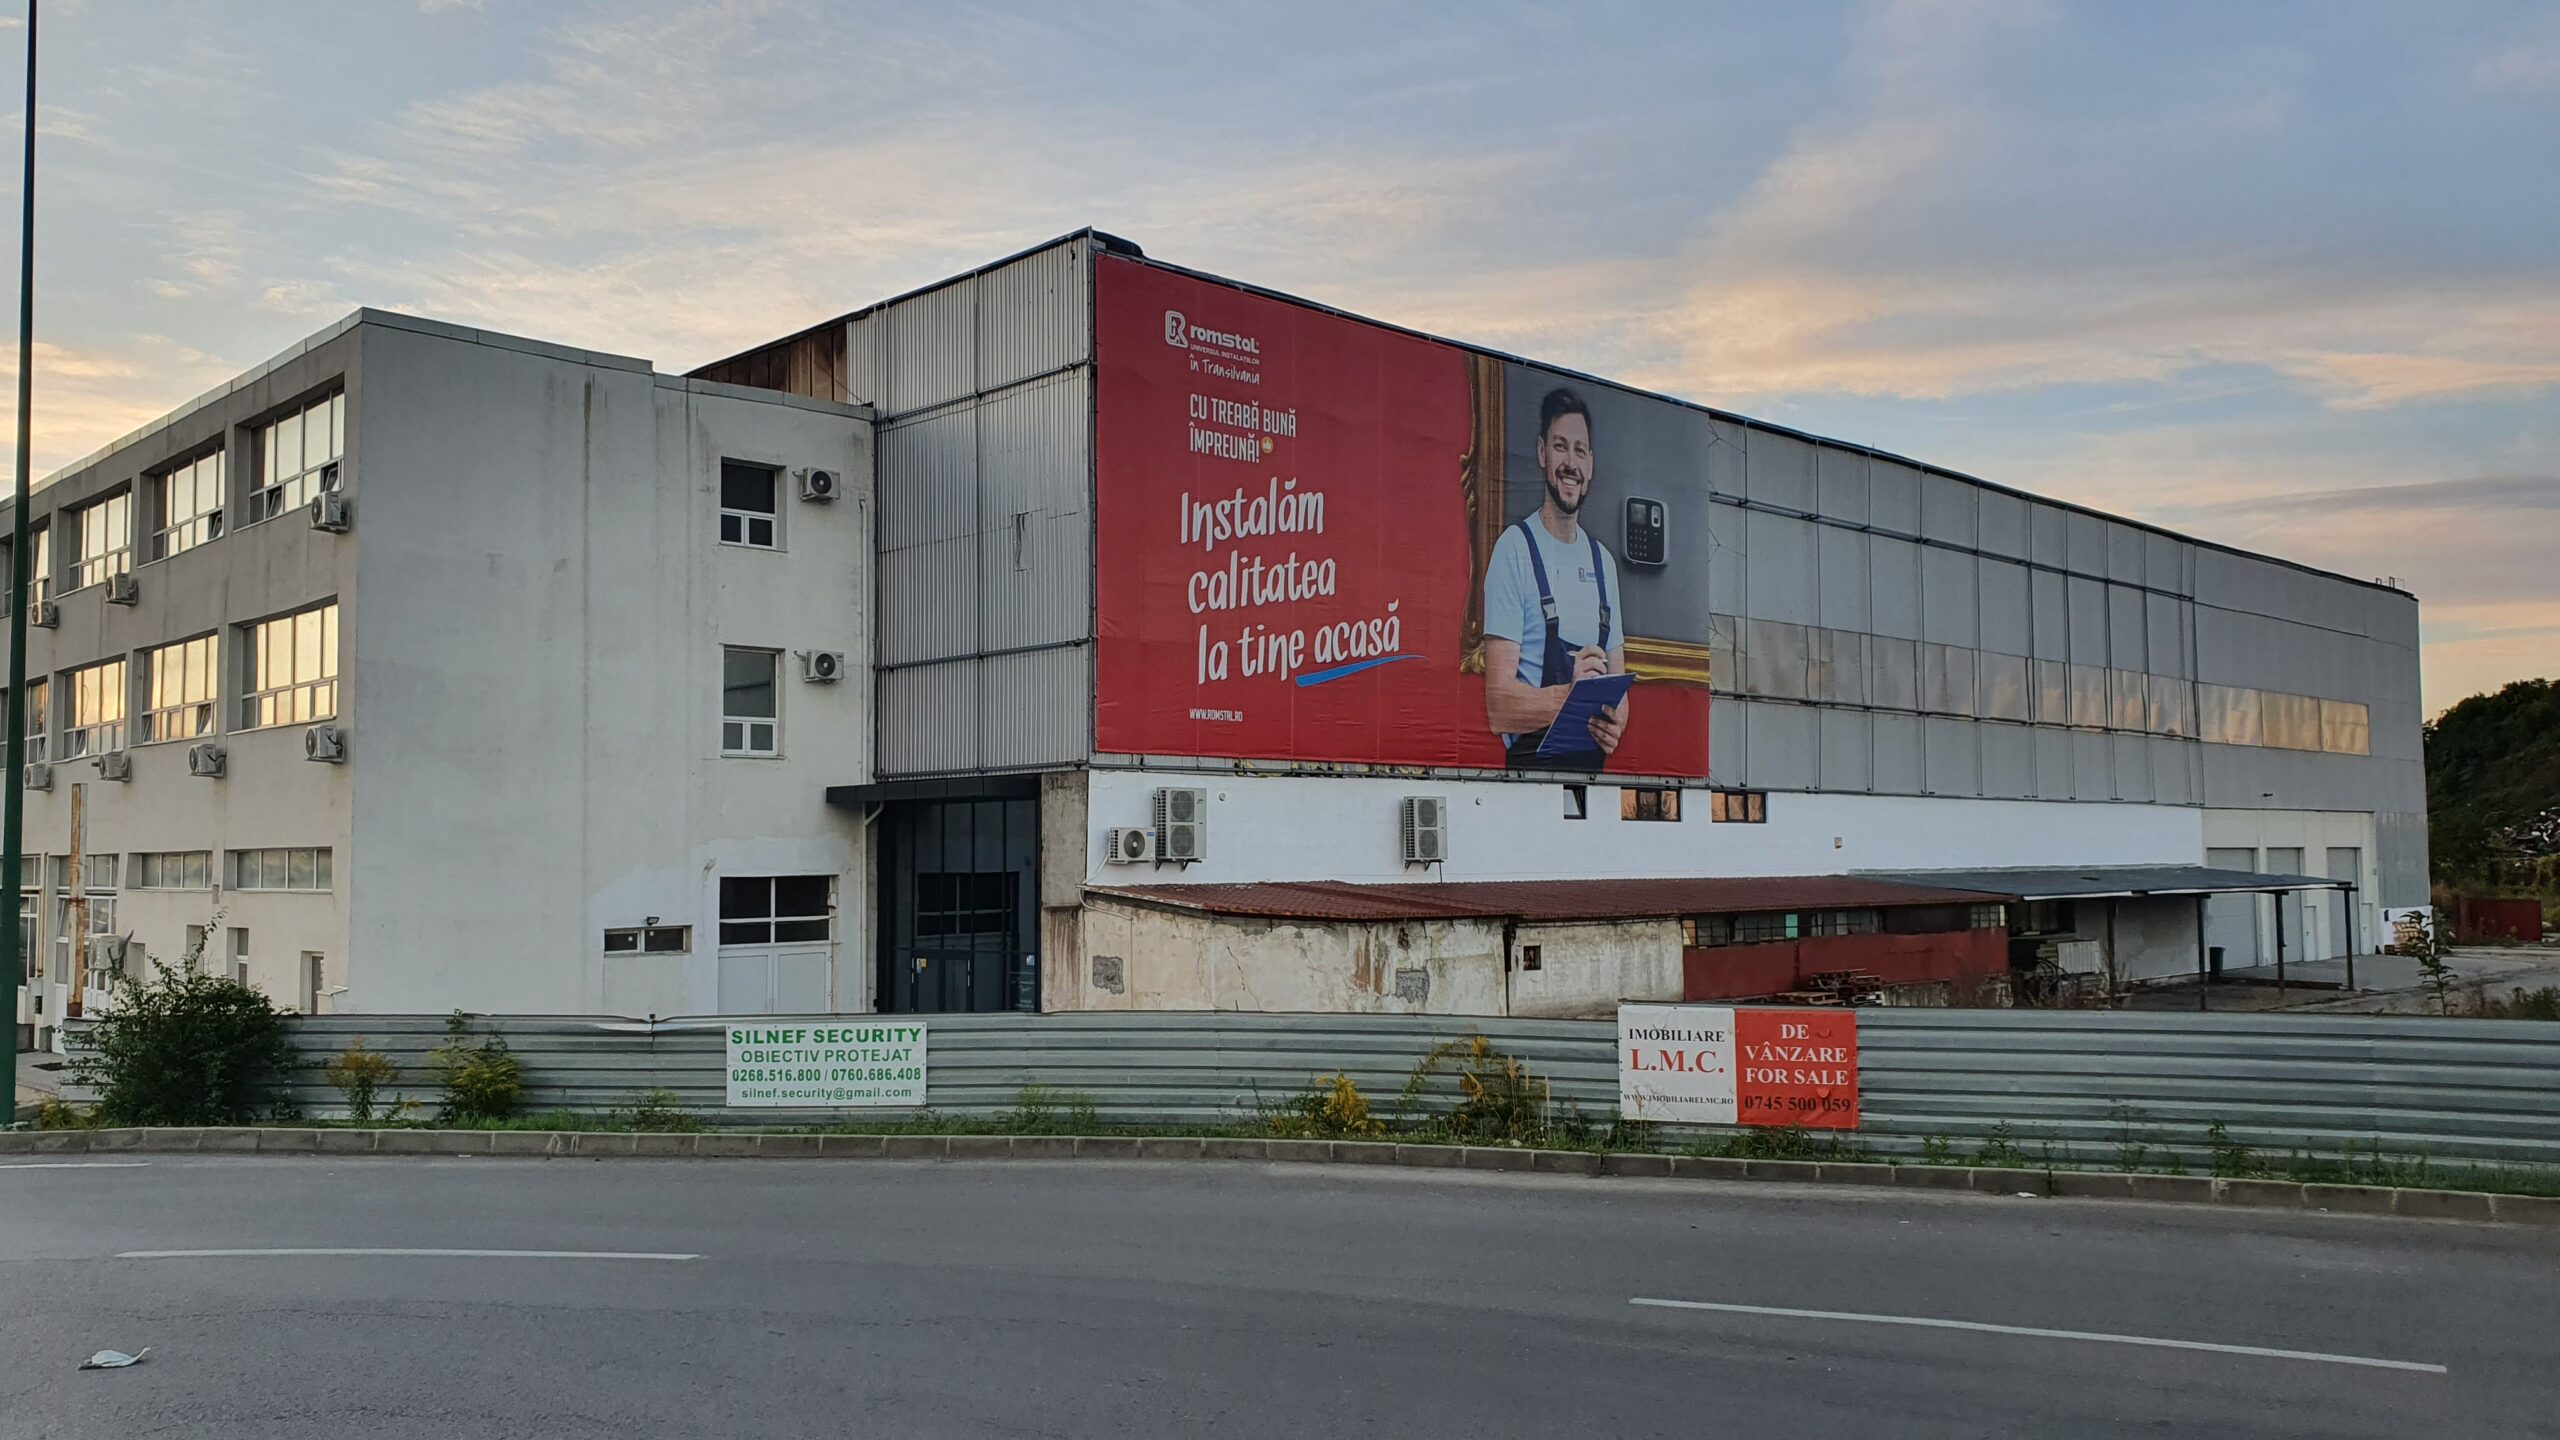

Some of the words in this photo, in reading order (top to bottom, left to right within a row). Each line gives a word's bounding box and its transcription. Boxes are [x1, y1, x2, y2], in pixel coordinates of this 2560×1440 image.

[1189, 353, 1199, 372] în
[1202, 359, 1260, 385] Transilvania
[1190, 394, 1208, 420] CU
[1211, 399, 1259, 430] TREABĂ
[1263, 407, 1296, 437] BUNĂ
[1189, 421, 1260, 463] ÎMPREUNĂ!
[1181, 476, 1324, 552] Instalăm
[1187, 550, 1336, 614] calitatea
[1198, 624, 1229, 685] la
[1236, 624, 1305, 682] tine
[1315, 599, 1400, 664] acasă
[1189, 708, 1243, 722] WWW.ROMSTAL.RO
[731, 1029, 807, 1044] SILNEF
[813, 1028, 922, 1043] SECURITY
[1629, 1028, 1725, 1042] IMOBILIARE
[1781, 1024, 1810, 1040] DE
[741, 1050, 820, 1063] OBIECTIV
[824, 1049, 912, 1062] PROTEJAT
[1631, 1048, 1725, 1073] L.M.C.
[1745, 1041, 1848, 1063] VÂNZARE
[732, 1069, 821, 1082] 0268.516.800
[831, 1067, 921, 1081] 0760.686.408
[1745, 1068, 1788, 1084] FOR
[1794, 1070, 1849, 1085] SALE
[742, 1087, 912, 1100] silnef.security@gmail.com
[1744, 1096, 1783, 1110] 0745
[1788, 1097, 1817, 1111] 500
[1822, 1098, 1851, 1112] 059
